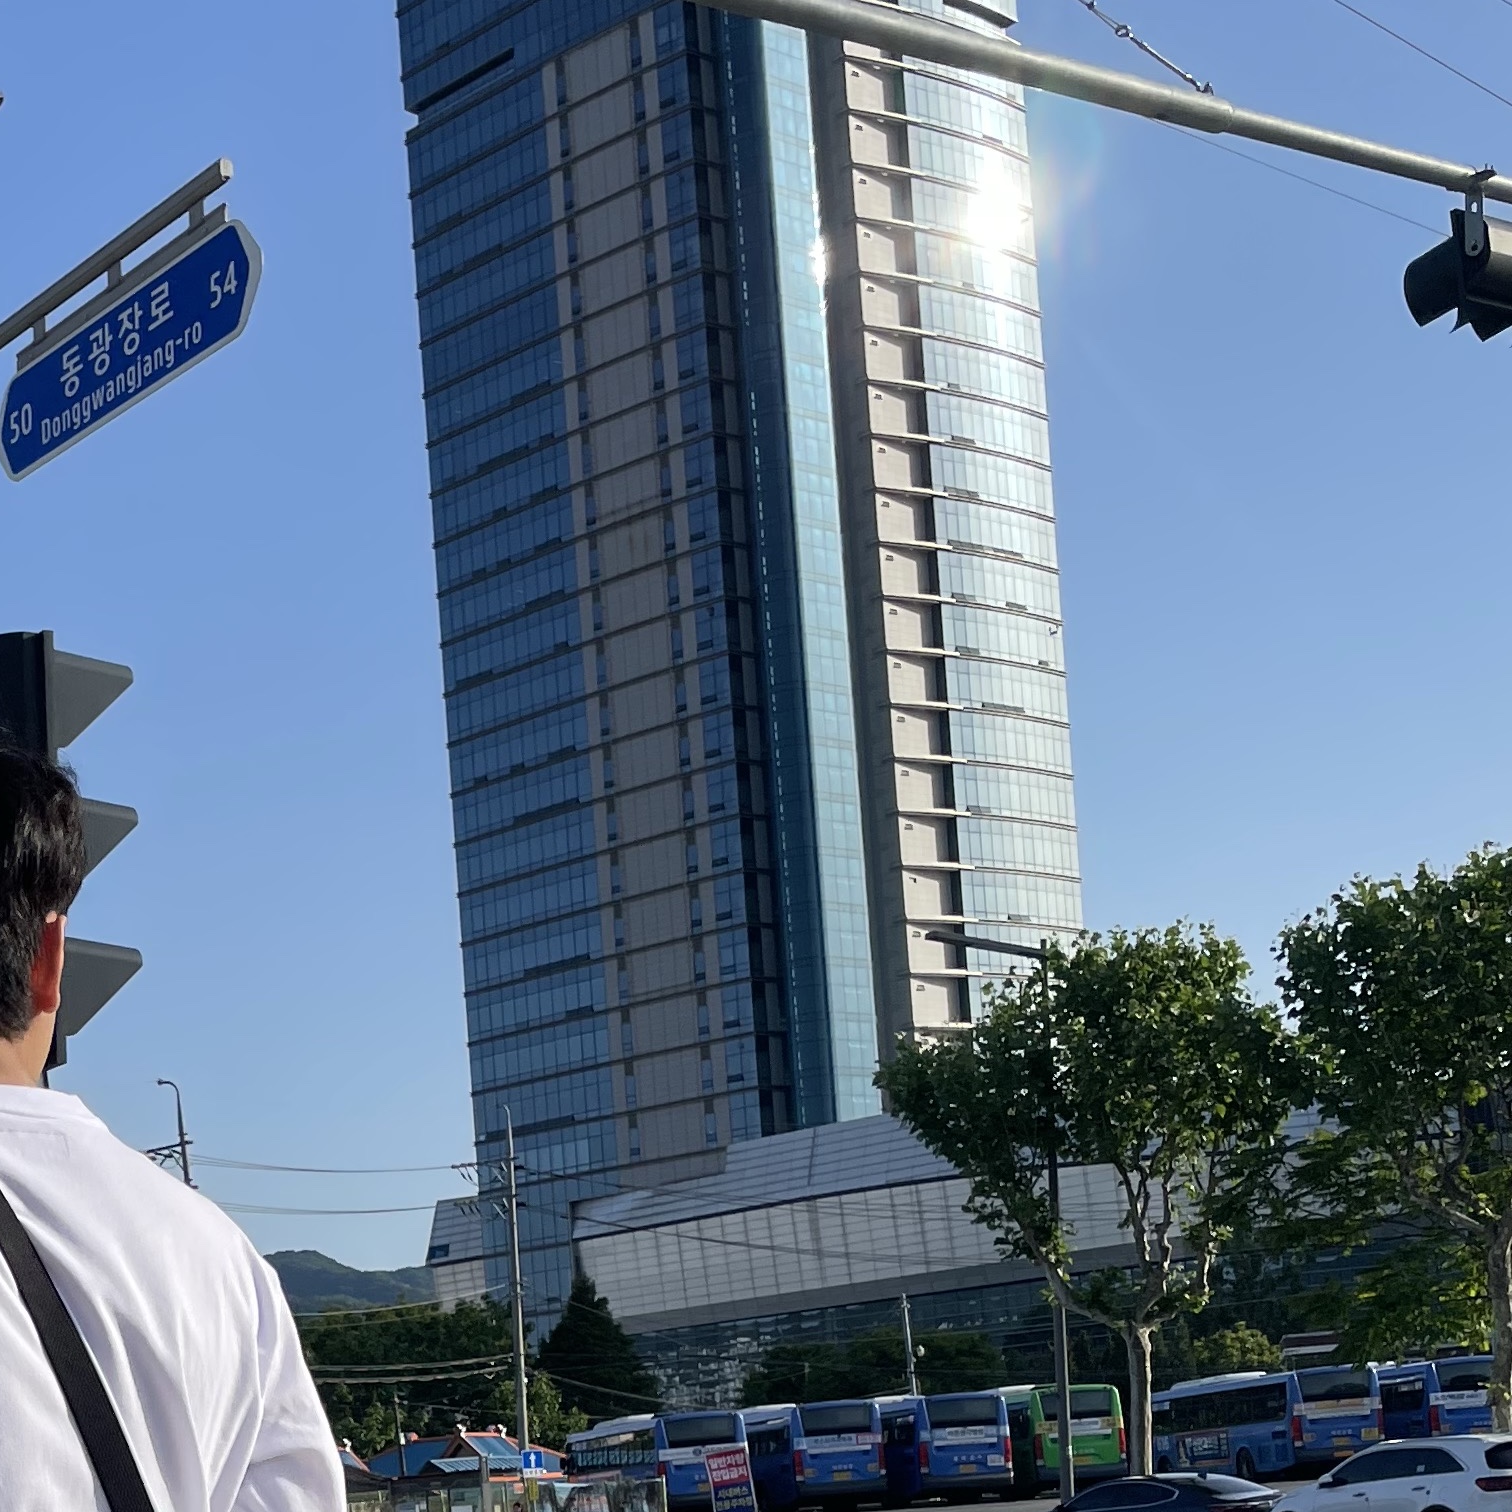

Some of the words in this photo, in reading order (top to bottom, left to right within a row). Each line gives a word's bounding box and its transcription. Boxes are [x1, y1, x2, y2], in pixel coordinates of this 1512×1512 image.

[209, 260, 238, 309] 54
[60, 280, 174, 398] 동광장로
[9, 402, 33, 444] 50
[40, 321, 203, 445] Donggwangjang-ro
